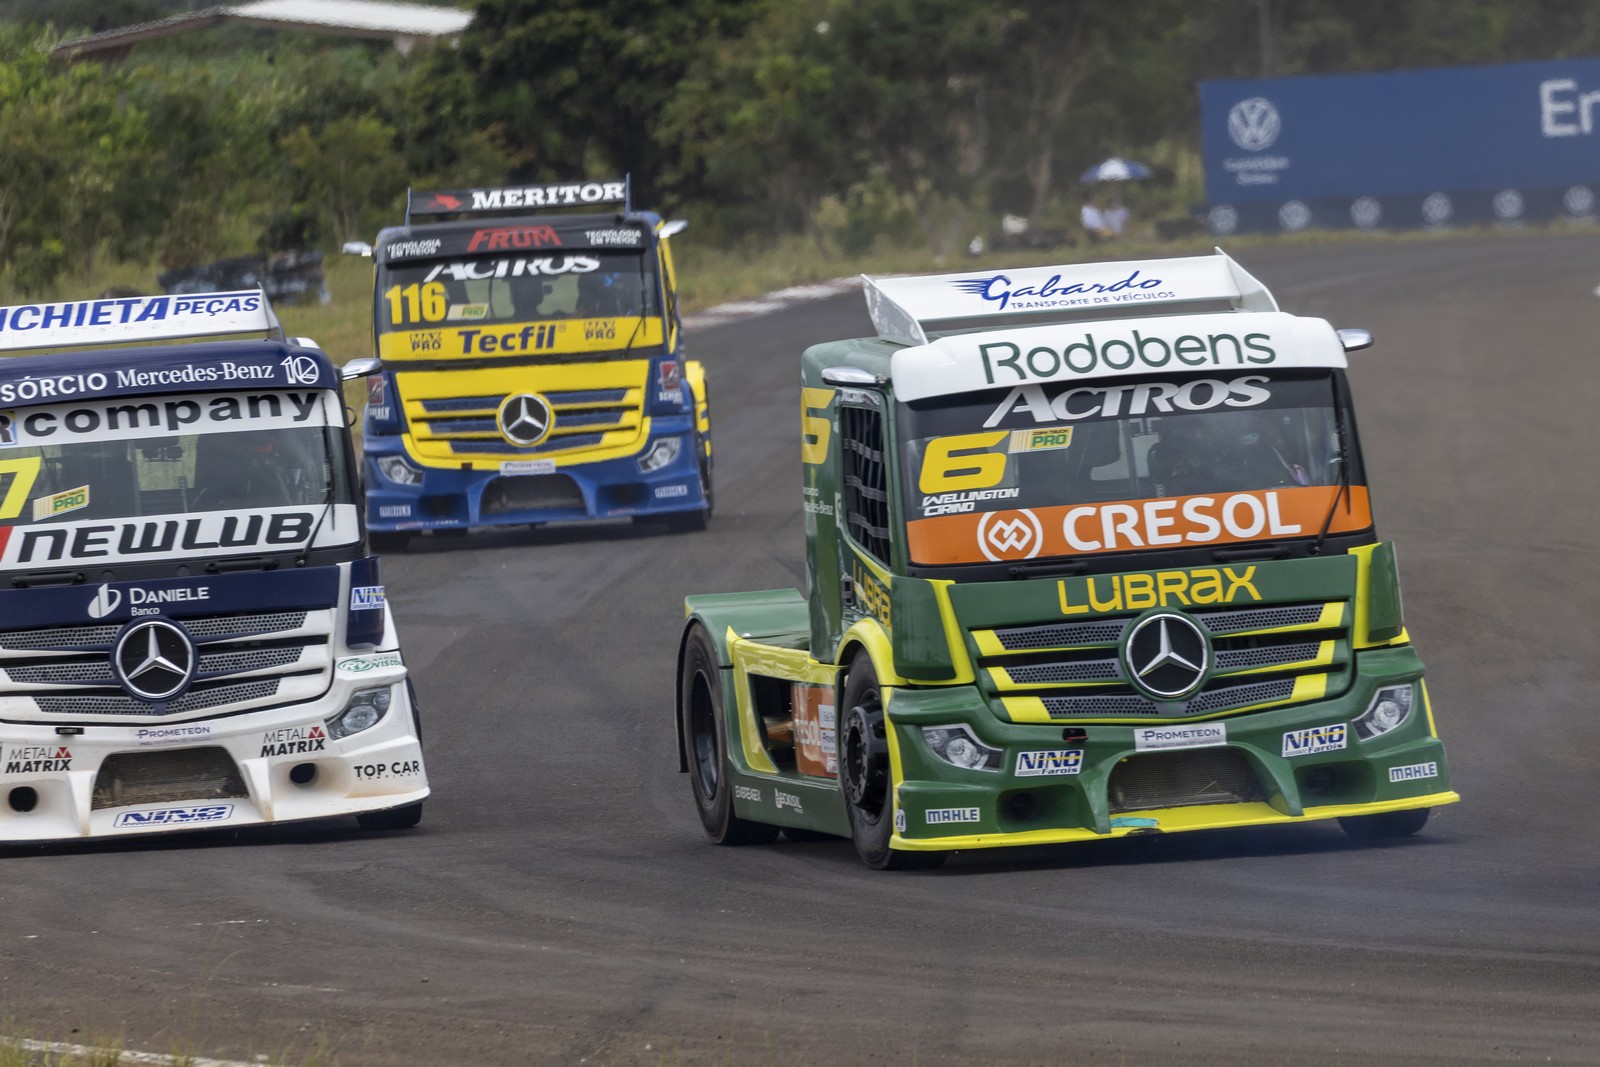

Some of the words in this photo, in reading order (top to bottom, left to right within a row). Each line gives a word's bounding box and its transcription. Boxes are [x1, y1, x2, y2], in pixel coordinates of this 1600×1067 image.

[472, 182, 626, 210] MERITOR
[466, 225, 563, 253] FRUM
[423, 254, 601, 284] ACTROS
[980, 270, 1163, 311] Gabardo
[173, 297, 261, 317] PEÇAS
[385, 281, 447, 325] 116
[1010, 298, 1090, 310] TRANSPORTE
[1092, 296, 1109, 304] DE
[1114, 291, 1176, 303] VEÍCULOS
[411, 342, 442, 352] PRO
[457, 324, 557, 354] Tecfil
[978, 330, 1276, 384] Rodobens
[115, 361, 275, 389] Mercedes-Benz
[982, 375, 1271, 428] ACTROS
[24, 391, 319, 439] company
[1032, 433, 1067, 448] PRO
[918, 430, 1011, 494] 6
[53, 493, 85, 511] PRO
[922, 487, 1020, 507] WELLINGTON
[923, 501, 976, 517] CIRINO
[1063, 485, 1302, 552] CRESOL
[129, 586, 210, 604] DANIELE
[131, 606, 160, 616] Banco
[136, 726, 211, 739] PROMETEON
[263, 728, 308, 744] METAL
[1141, 728, 1221, 741] PROMETEON
[10, 747, 55, 760] METAL
[260, 738, 326, 758] MATRIX
[1308, 743, 1343, 754] Farois
[5, 759, 72, 774] MATRIX
[354, 764, 386, 778] TOP
[391, 760, 420, 774] CAR
[1041, 766, 1078, 775] Farois
[1391, 763, 1436, 781] MAHLE
[927, 808, 978, 823] MAHLE
